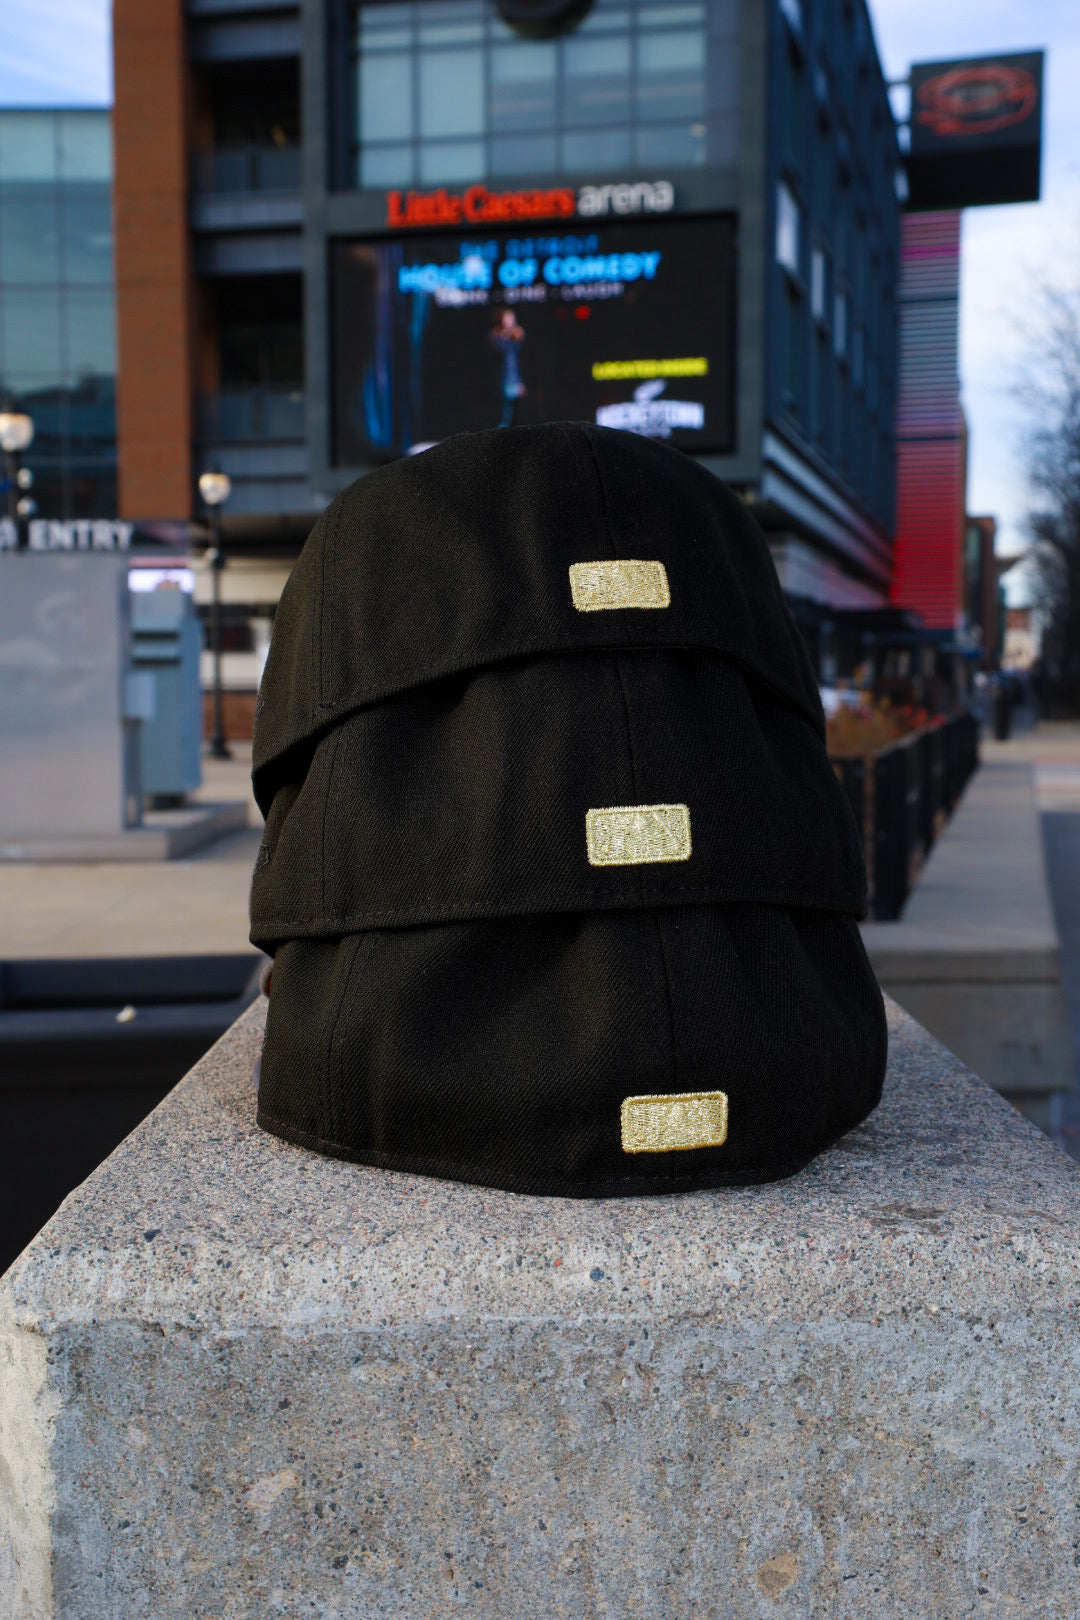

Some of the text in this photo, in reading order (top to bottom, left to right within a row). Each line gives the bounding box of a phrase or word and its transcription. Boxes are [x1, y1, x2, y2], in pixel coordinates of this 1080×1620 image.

[387, 180, 675, 227] Little Caesars arena
[498, 258, 539, 288] OF
[543, 251, 662, 286] COMEDY
[29, 518, 133, 550] ENTRY
